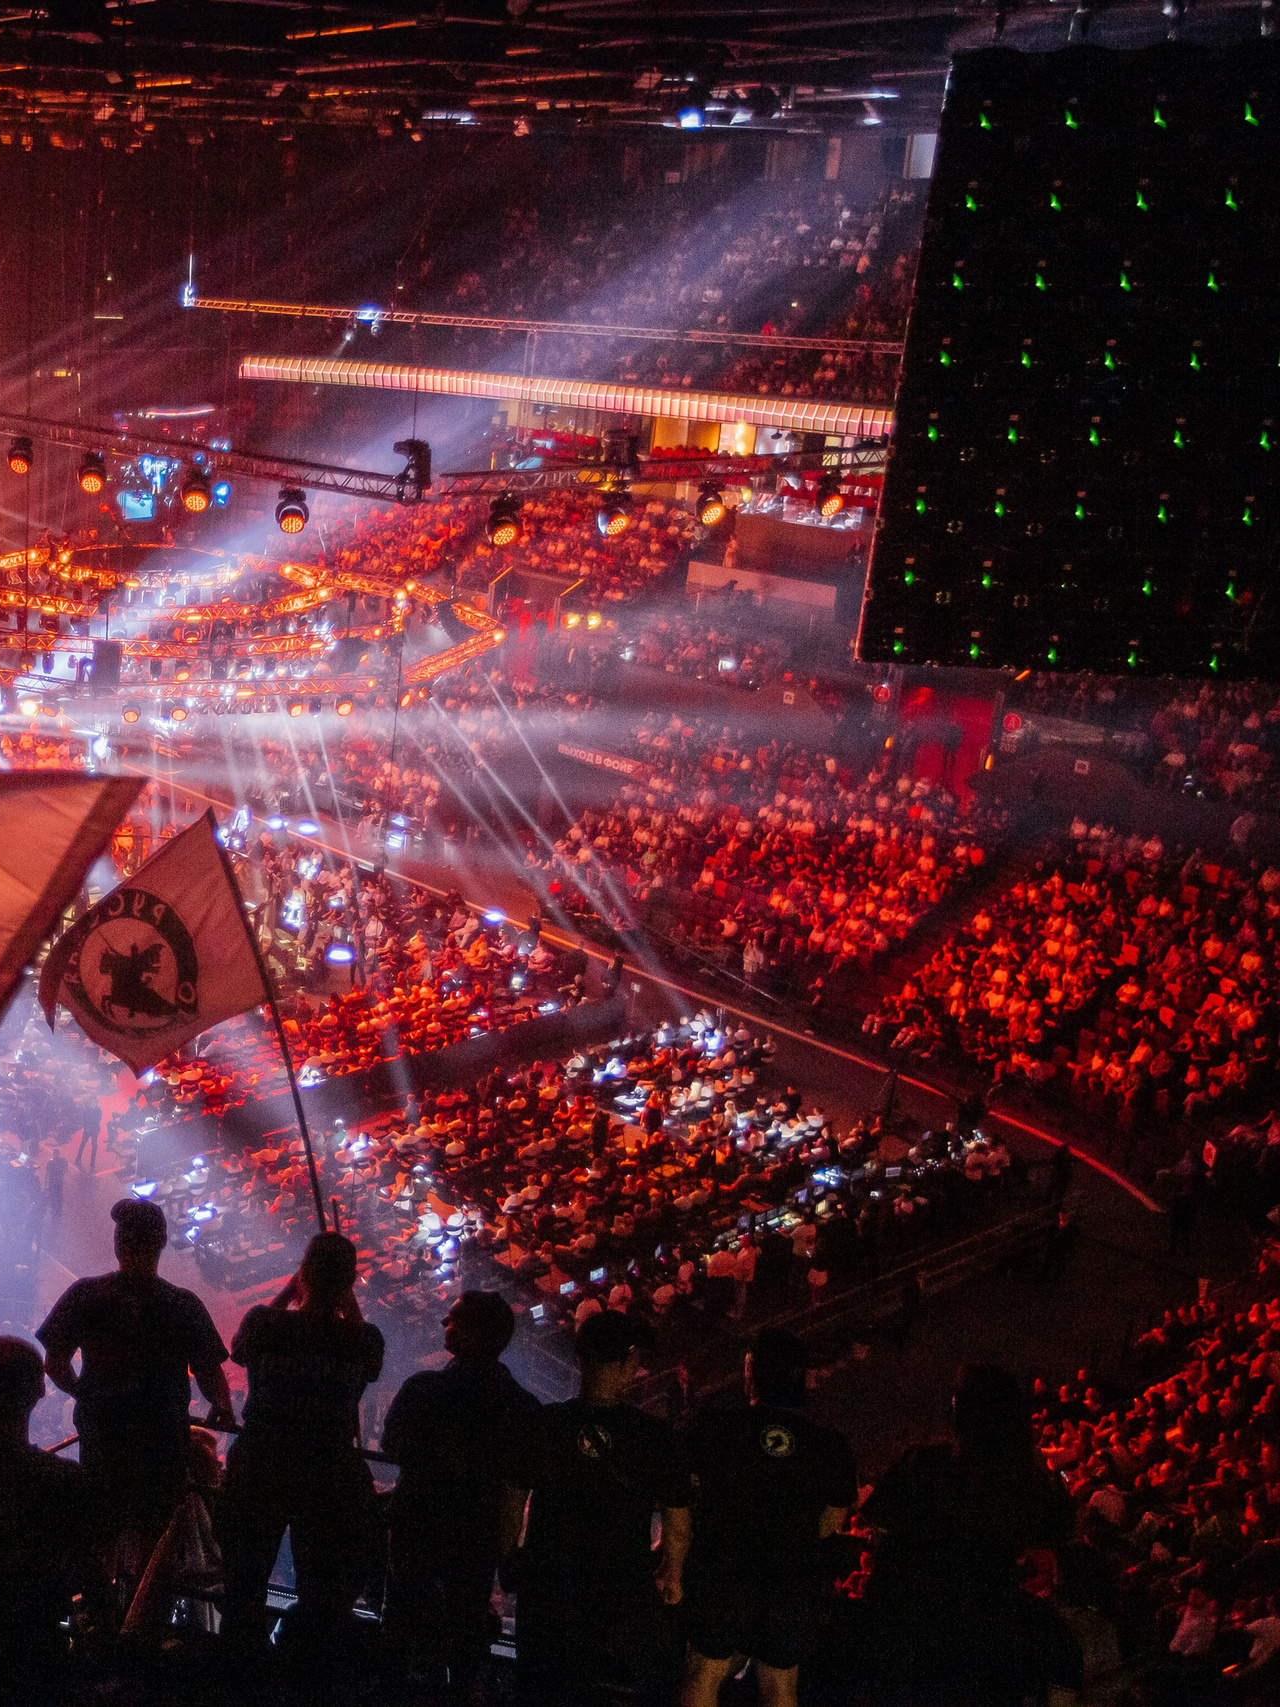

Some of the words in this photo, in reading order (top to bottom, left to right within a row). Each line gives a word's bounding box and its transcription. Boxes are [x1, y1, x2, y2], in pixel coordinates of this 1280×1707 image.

[558, 744, 593, 764] ВЫХОД
[595, 755, 602, 764] В
[603, 757, 633, 773] ФОЙЕ
